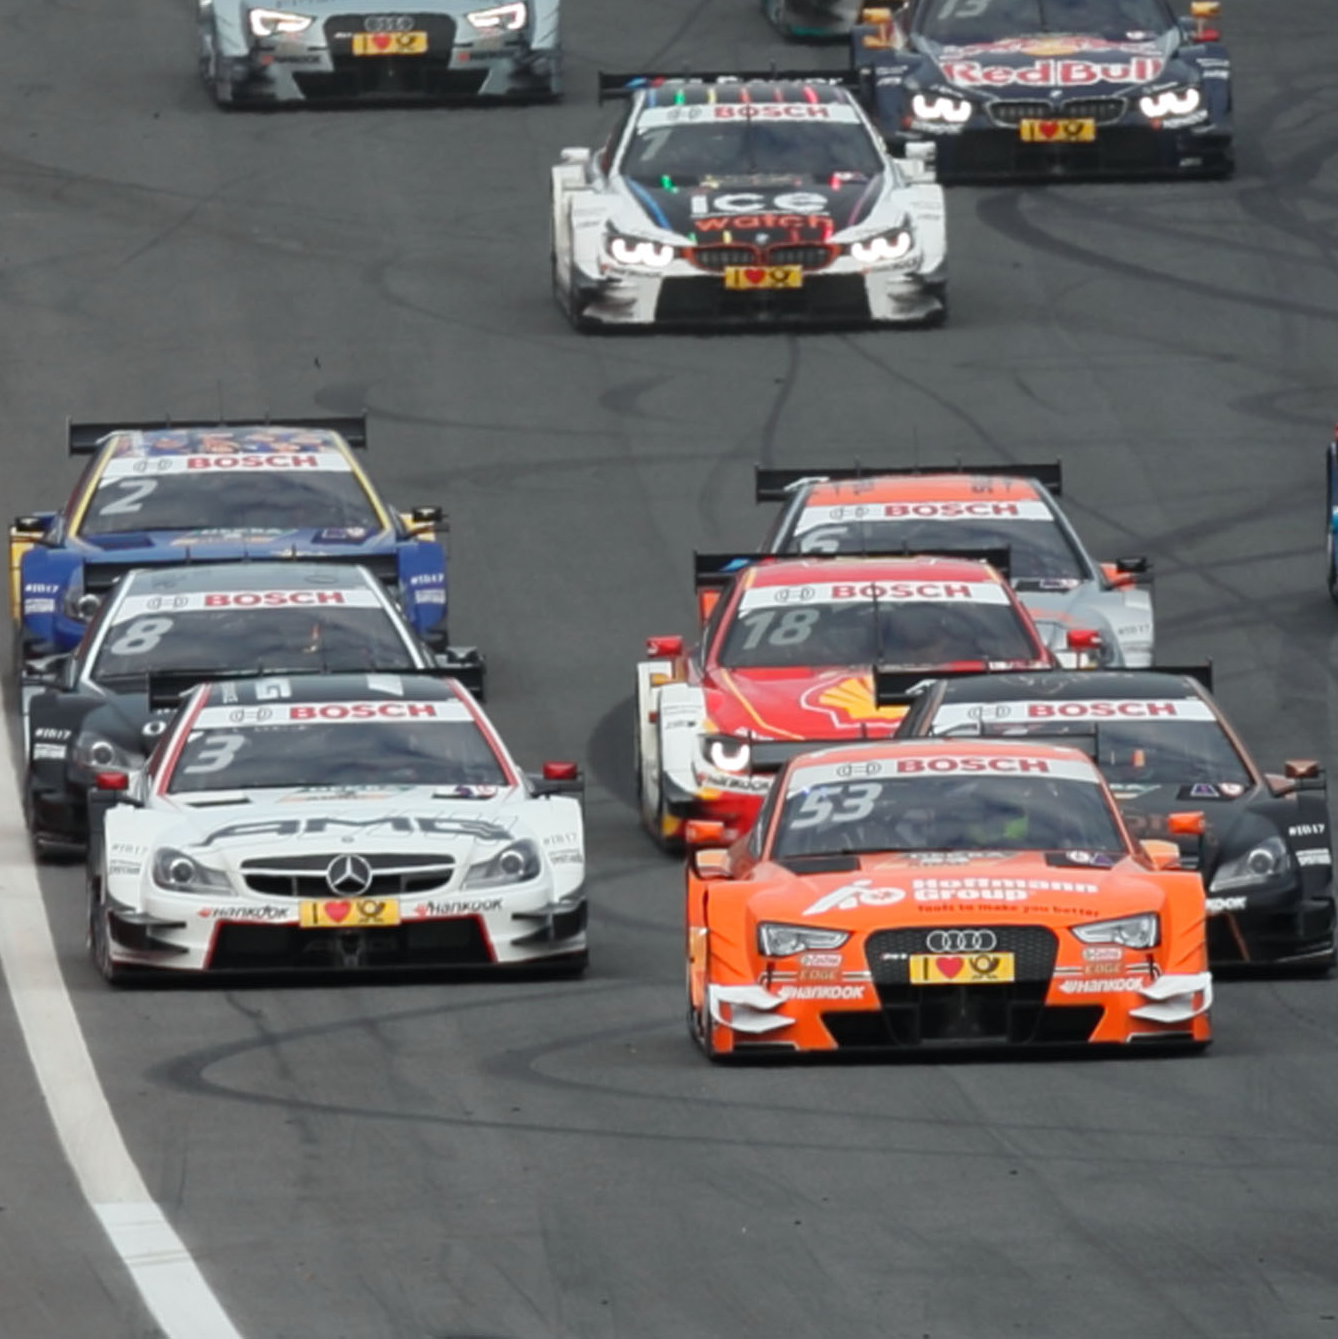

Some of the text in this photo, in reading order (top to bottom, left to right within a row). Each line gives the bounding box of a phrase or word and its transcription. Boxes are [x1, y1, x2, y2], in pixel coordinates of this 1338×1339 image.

[942, 57, 1162, 86] Red Bull
[713, 105, 830, 118] BOSCH
[691, 192, 829, 214] ice
[694, 214, 833, 232] watch
[186, 455, 319, 469] BOSCH
[98, 479, 157, 514] 2
[883, 504, 1020, 516] BOSCH
[799, 526, 850, 554] 6
[204, 591, 346, 608] BOSCH
[830, 584, 972, 599] BOSCH
[111, 617, 174, 655] 8
[742, 608, 820, 649] 18
[289, 703, 436, 720] BOSCH
[1027, 702, 1178, 718] BOSCH
[182, 735, 245, 774] 3
[895, 757, 1050, 773] BOSCH
[788, 782, 883, 829] 53
[912, 877, 1099, 894] Hoffmann
[913, 888, 1029, 902] Group
